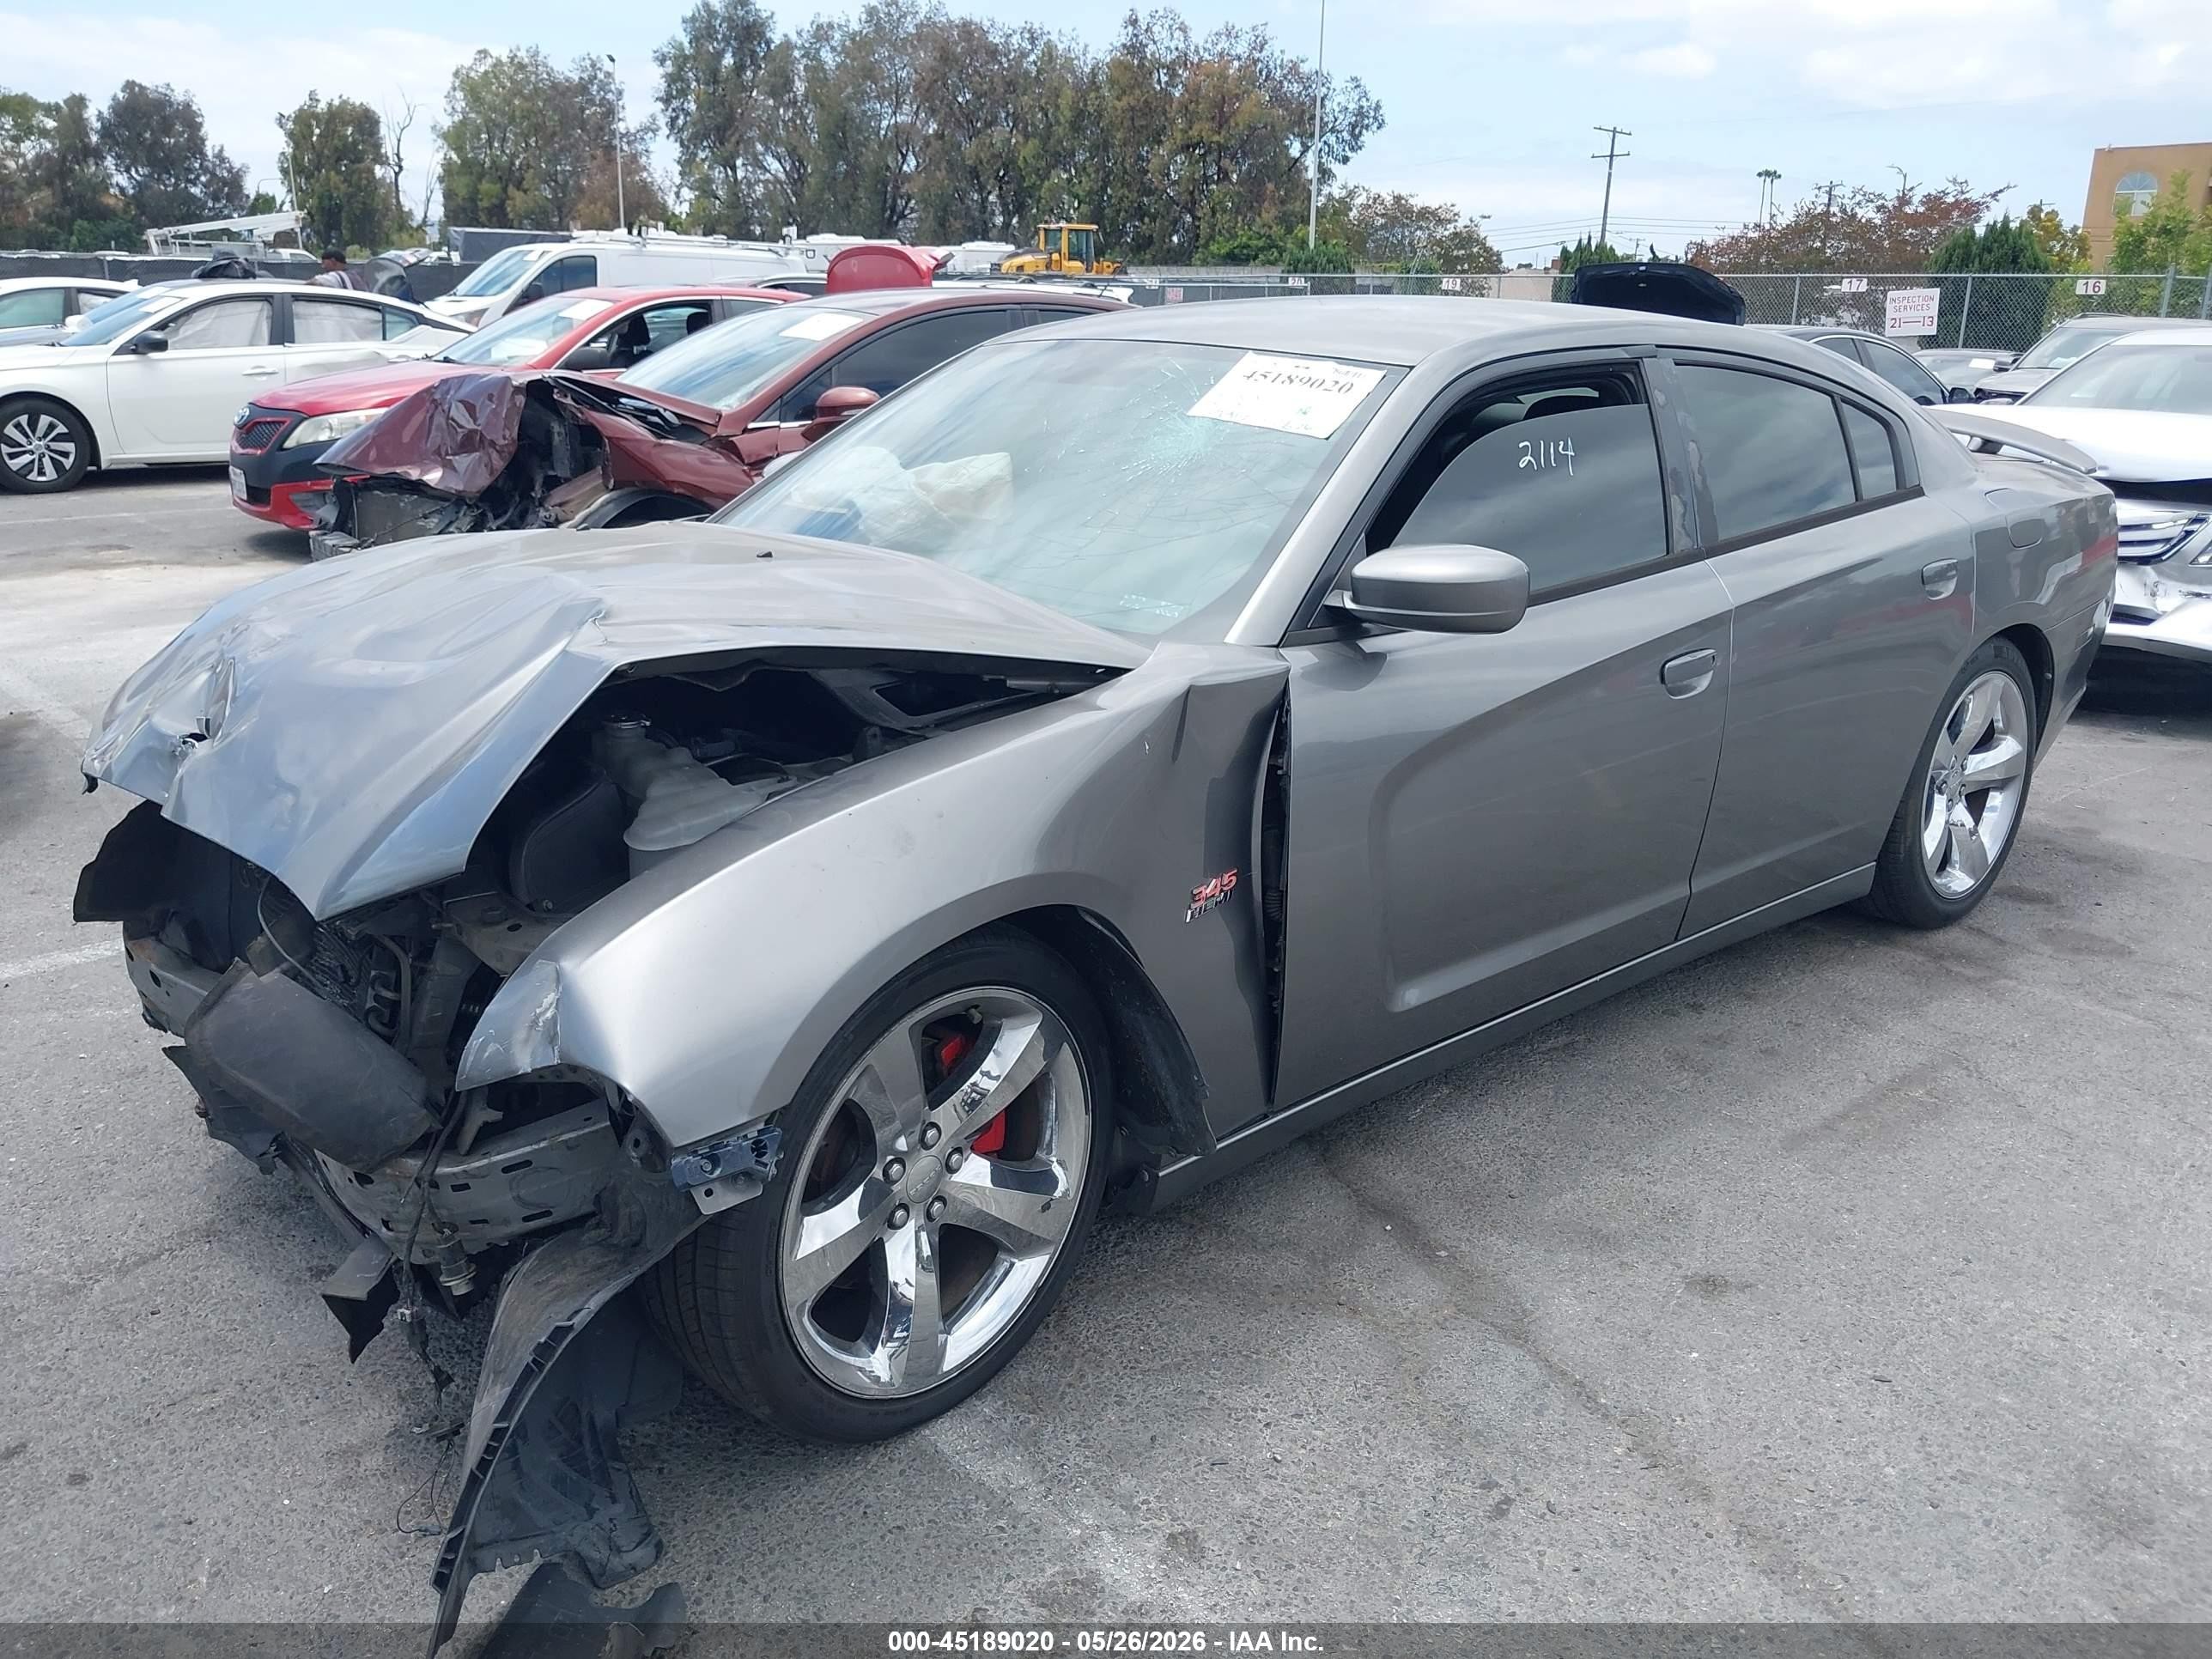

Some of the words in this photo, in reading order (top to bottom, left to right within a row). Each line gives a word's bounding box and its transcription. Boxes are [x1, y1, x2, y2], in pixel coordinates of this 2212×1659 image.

[1445, 279, 1458, 289] 19
[1846, 279, 1864, 291] 17
[2082, 280, 2101, 294] 16
[1889, 295, 1935, 305] INSPECTION
[1893, 303, 1930, 313] SERVICES
[1243, 370, 1354, 394] 45189020
[1518, 437, 1575, 476] 2114
[1191, 868, 1238, 910] 345
